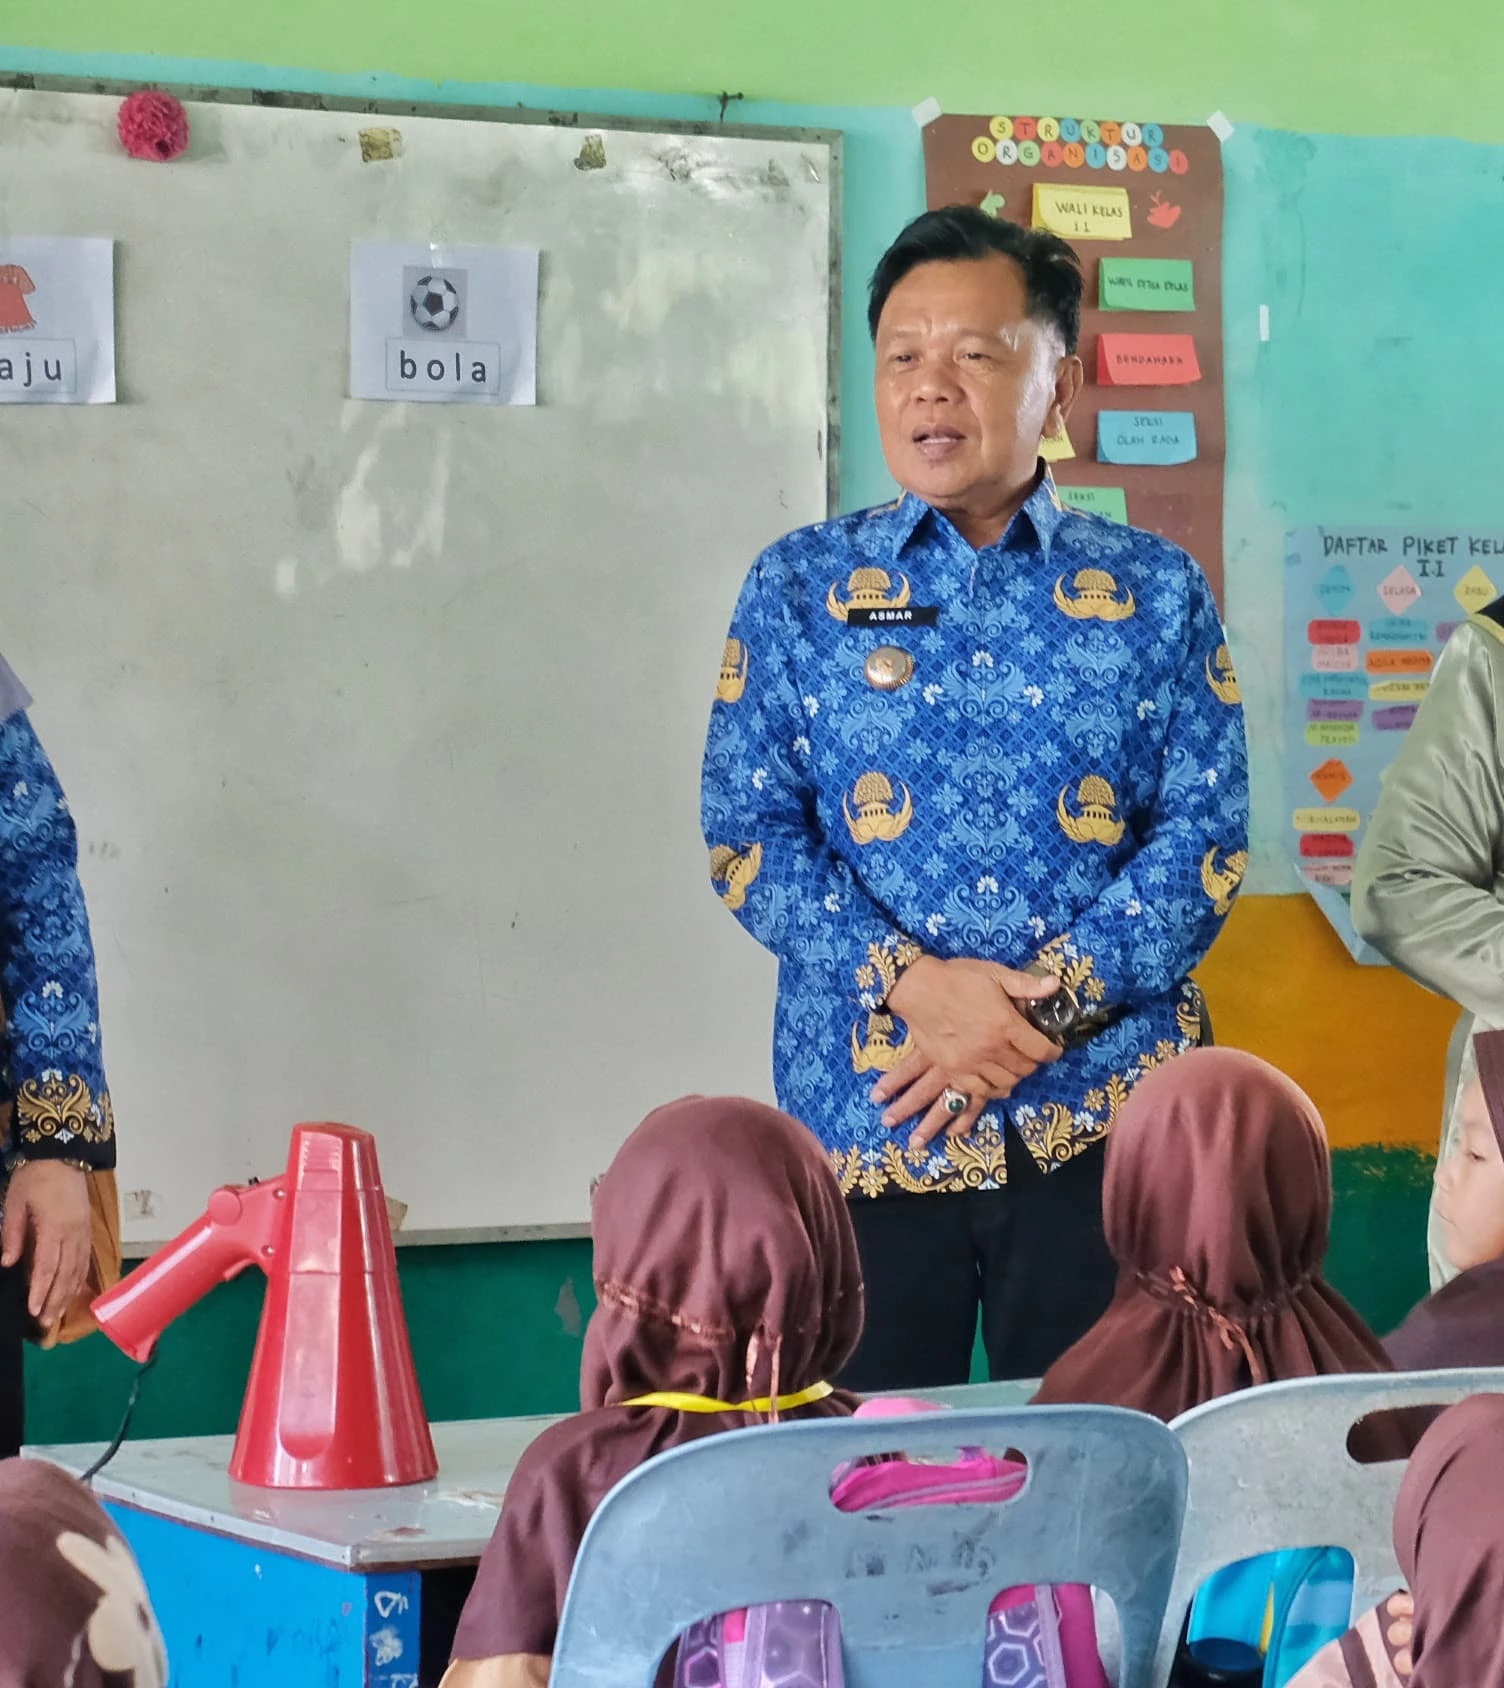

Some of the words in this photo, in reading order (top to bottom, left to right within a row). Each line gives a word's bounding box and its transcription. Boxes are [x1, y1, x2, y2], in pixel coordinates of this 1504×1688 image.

[996, 118, 1156, 142] STRUKTUR
[977, 142, 1182, 167] ORGANISASI
[399, 350, 487, 383] bola
[1322, 535, 1388, 557] DAFTAR
[1402, 535, 1459, 556] PIKET
[868, 610, 913, 621] ASMAR
